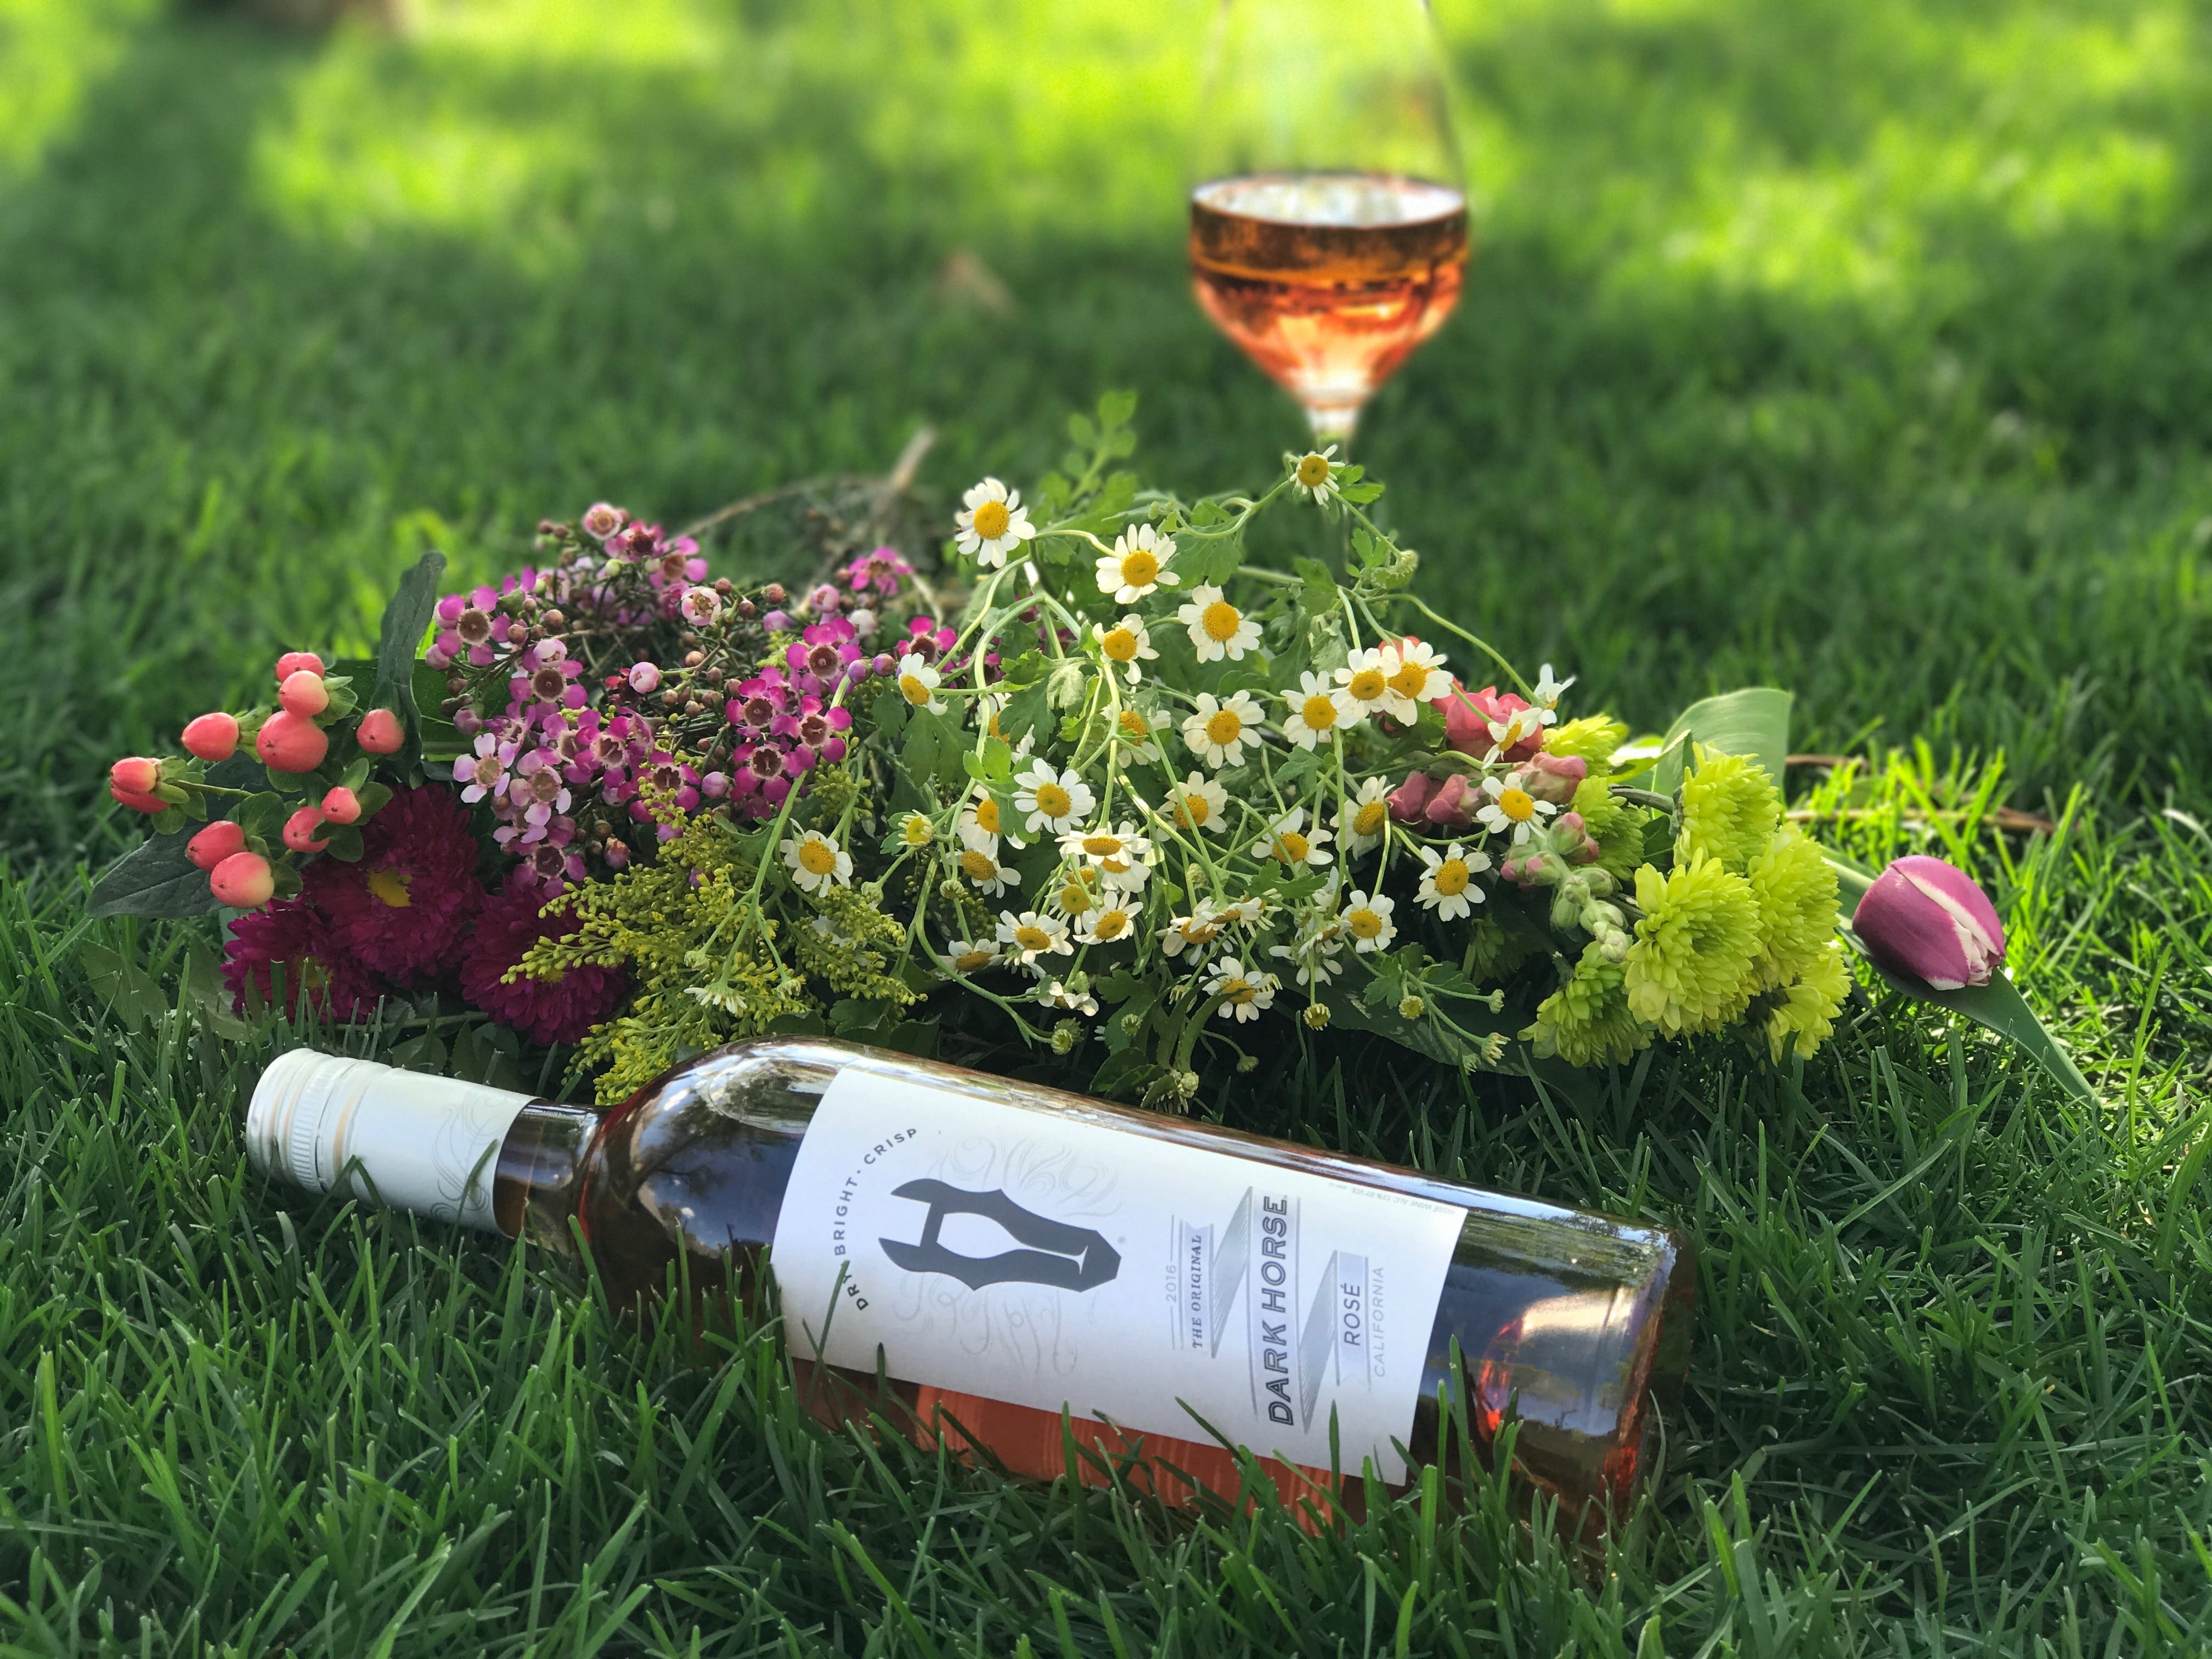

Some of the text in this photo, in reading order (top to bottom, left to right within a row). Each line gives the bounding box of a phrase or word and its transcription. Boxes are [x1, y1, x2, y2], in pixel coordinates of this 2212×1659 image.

[833, 1128, 917, 1311] DRY BRIGHT CRISP
[1165, 1264, 1177, 1304] 2016
[1190, 1234, 1203, 1349] THE ORIGINAL
[1261, 1196, 1295, 1426] DARK HORSE
[1340, 1283, 1361, 1346] ROSÉ
[1372, 1267, 1386, 1378] CALIFORNIA
